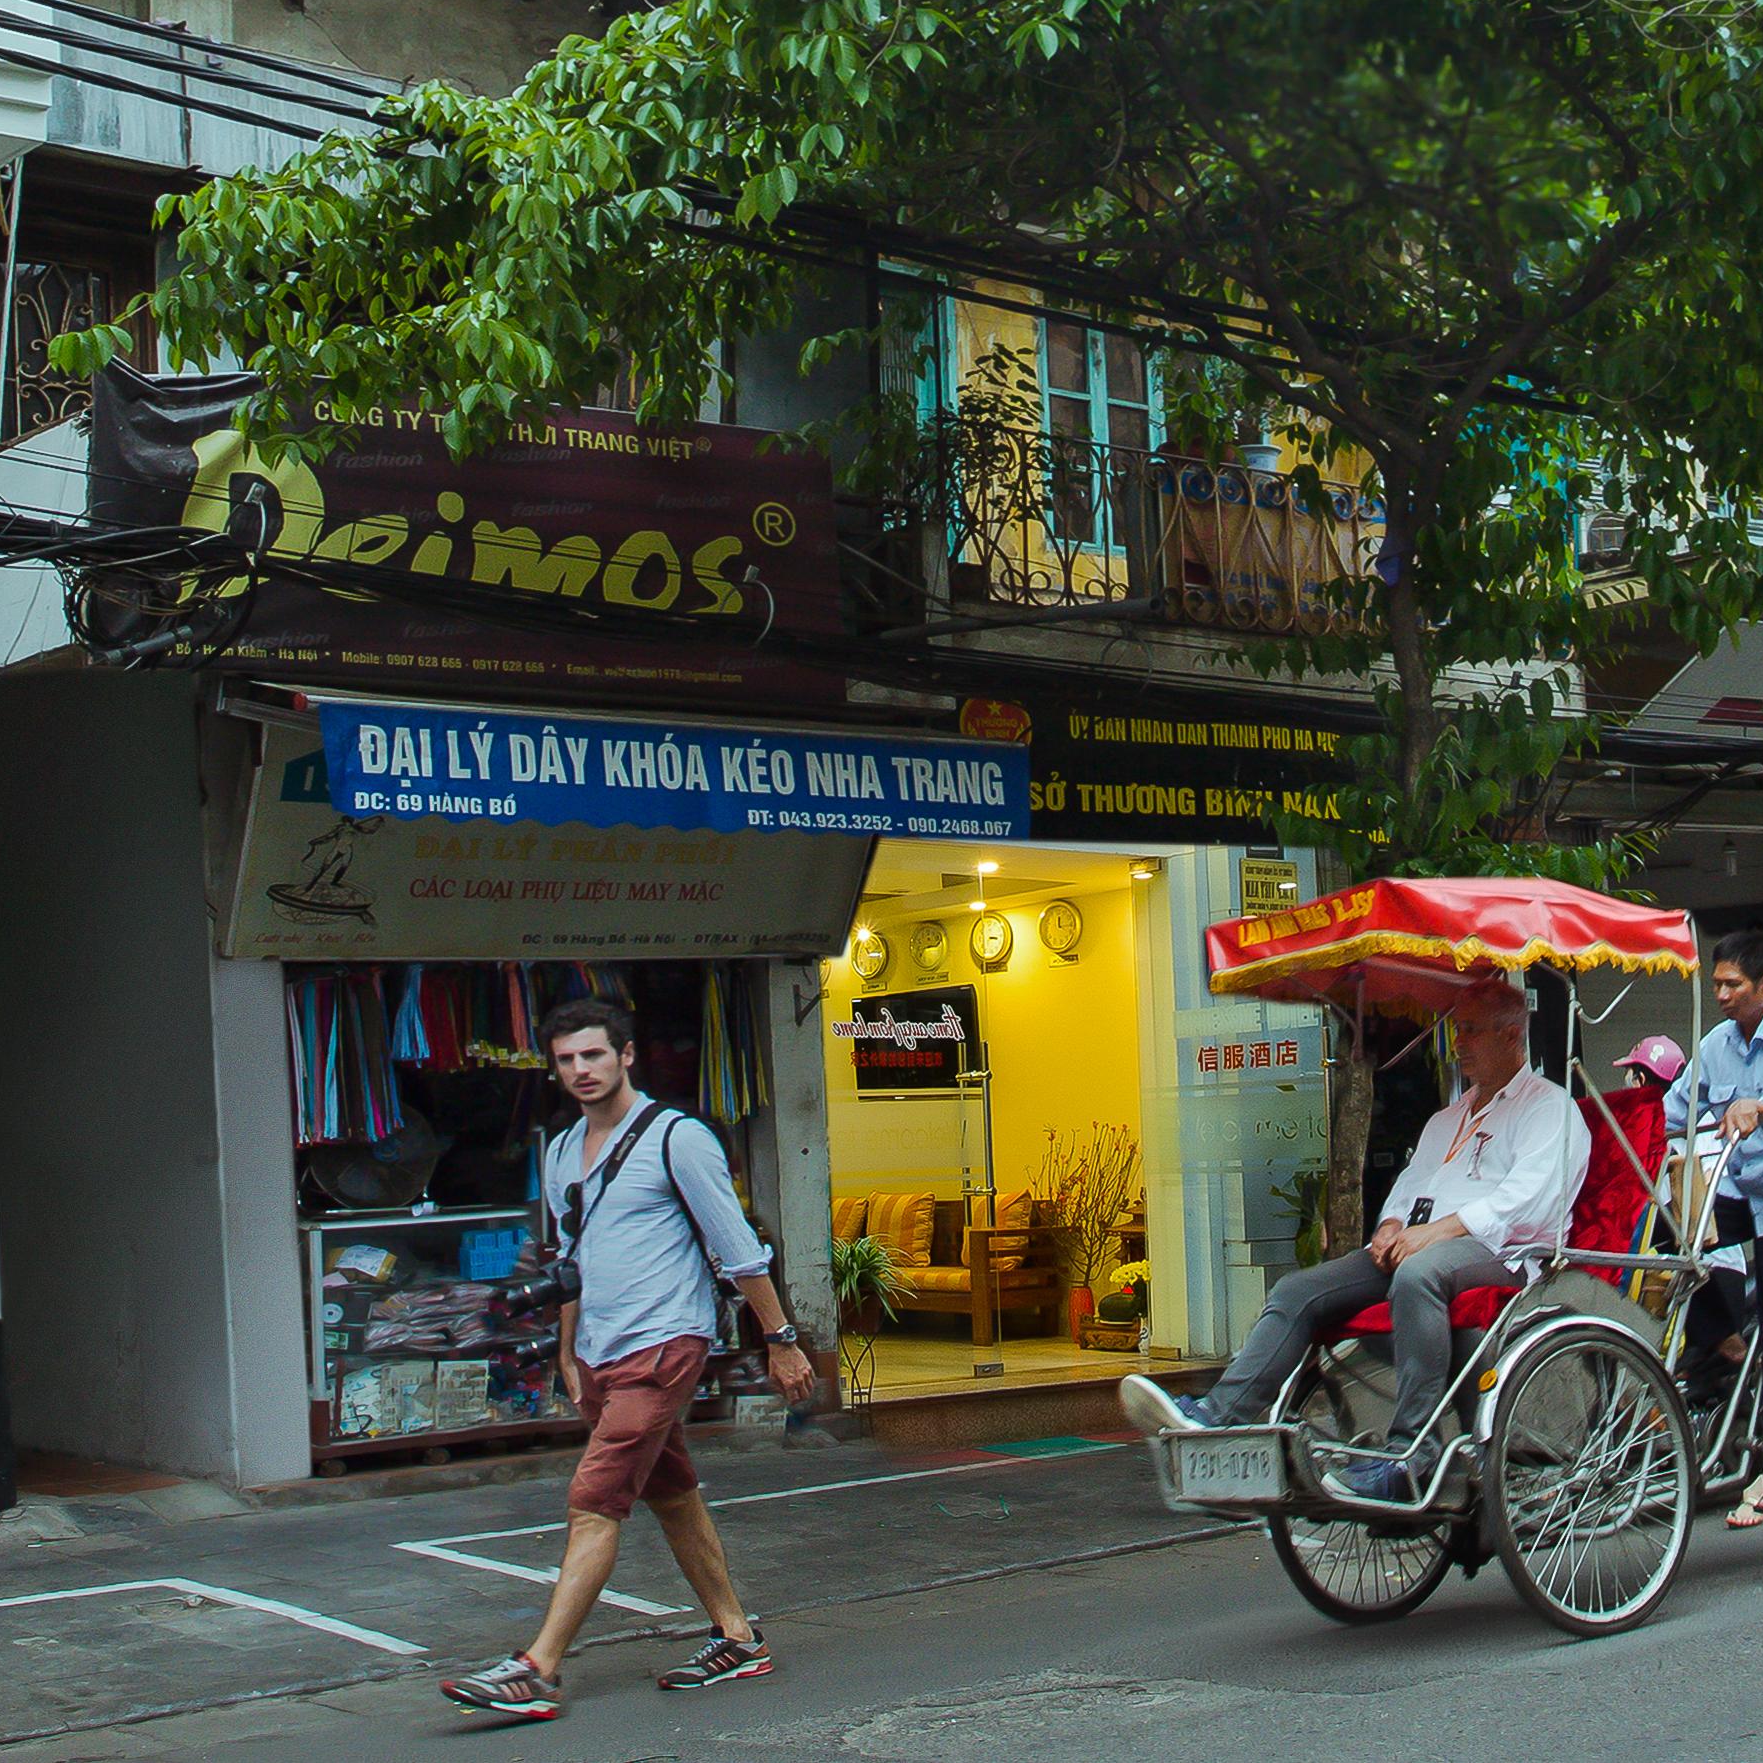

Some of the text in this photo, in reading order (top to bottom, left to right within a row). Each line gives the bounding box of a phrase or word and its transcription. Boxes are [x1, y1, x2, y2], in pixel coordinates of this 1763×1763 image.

[564, 428, 638, 454] TRANG
[342, 651, 383, 665] Mobile:
[387, 654, 414, 666] 0907
[359, 725, 433, 787] ĐẠI
[447, 722, 494, 779] LÝ
[509, 726, 588, 786] DÂY
[602, 733, 710, 792] KHÓA
[721, 739, 795, 795] KÉO
[807, 752, 884, 800] NHA
[892, 757, 1005, 806] TRANG
[354, 792, 390, 812] ĐC:
[396, 794, 422, 812] 69
[429, 792, 483, 815] HÀNG
[1030, 771, 1067, 813] SỞ
[1076, 781, 1197, 817] THƯƠNG
[748, 809, 1012, 838] ĐT: 043.923.3252 090.2468.067
[410, 875, 724, 905] CÁC LOẠI PHỤ LIỆU MAY MẶC
[1197, 1039, 1299, 1073] 信服酒店
